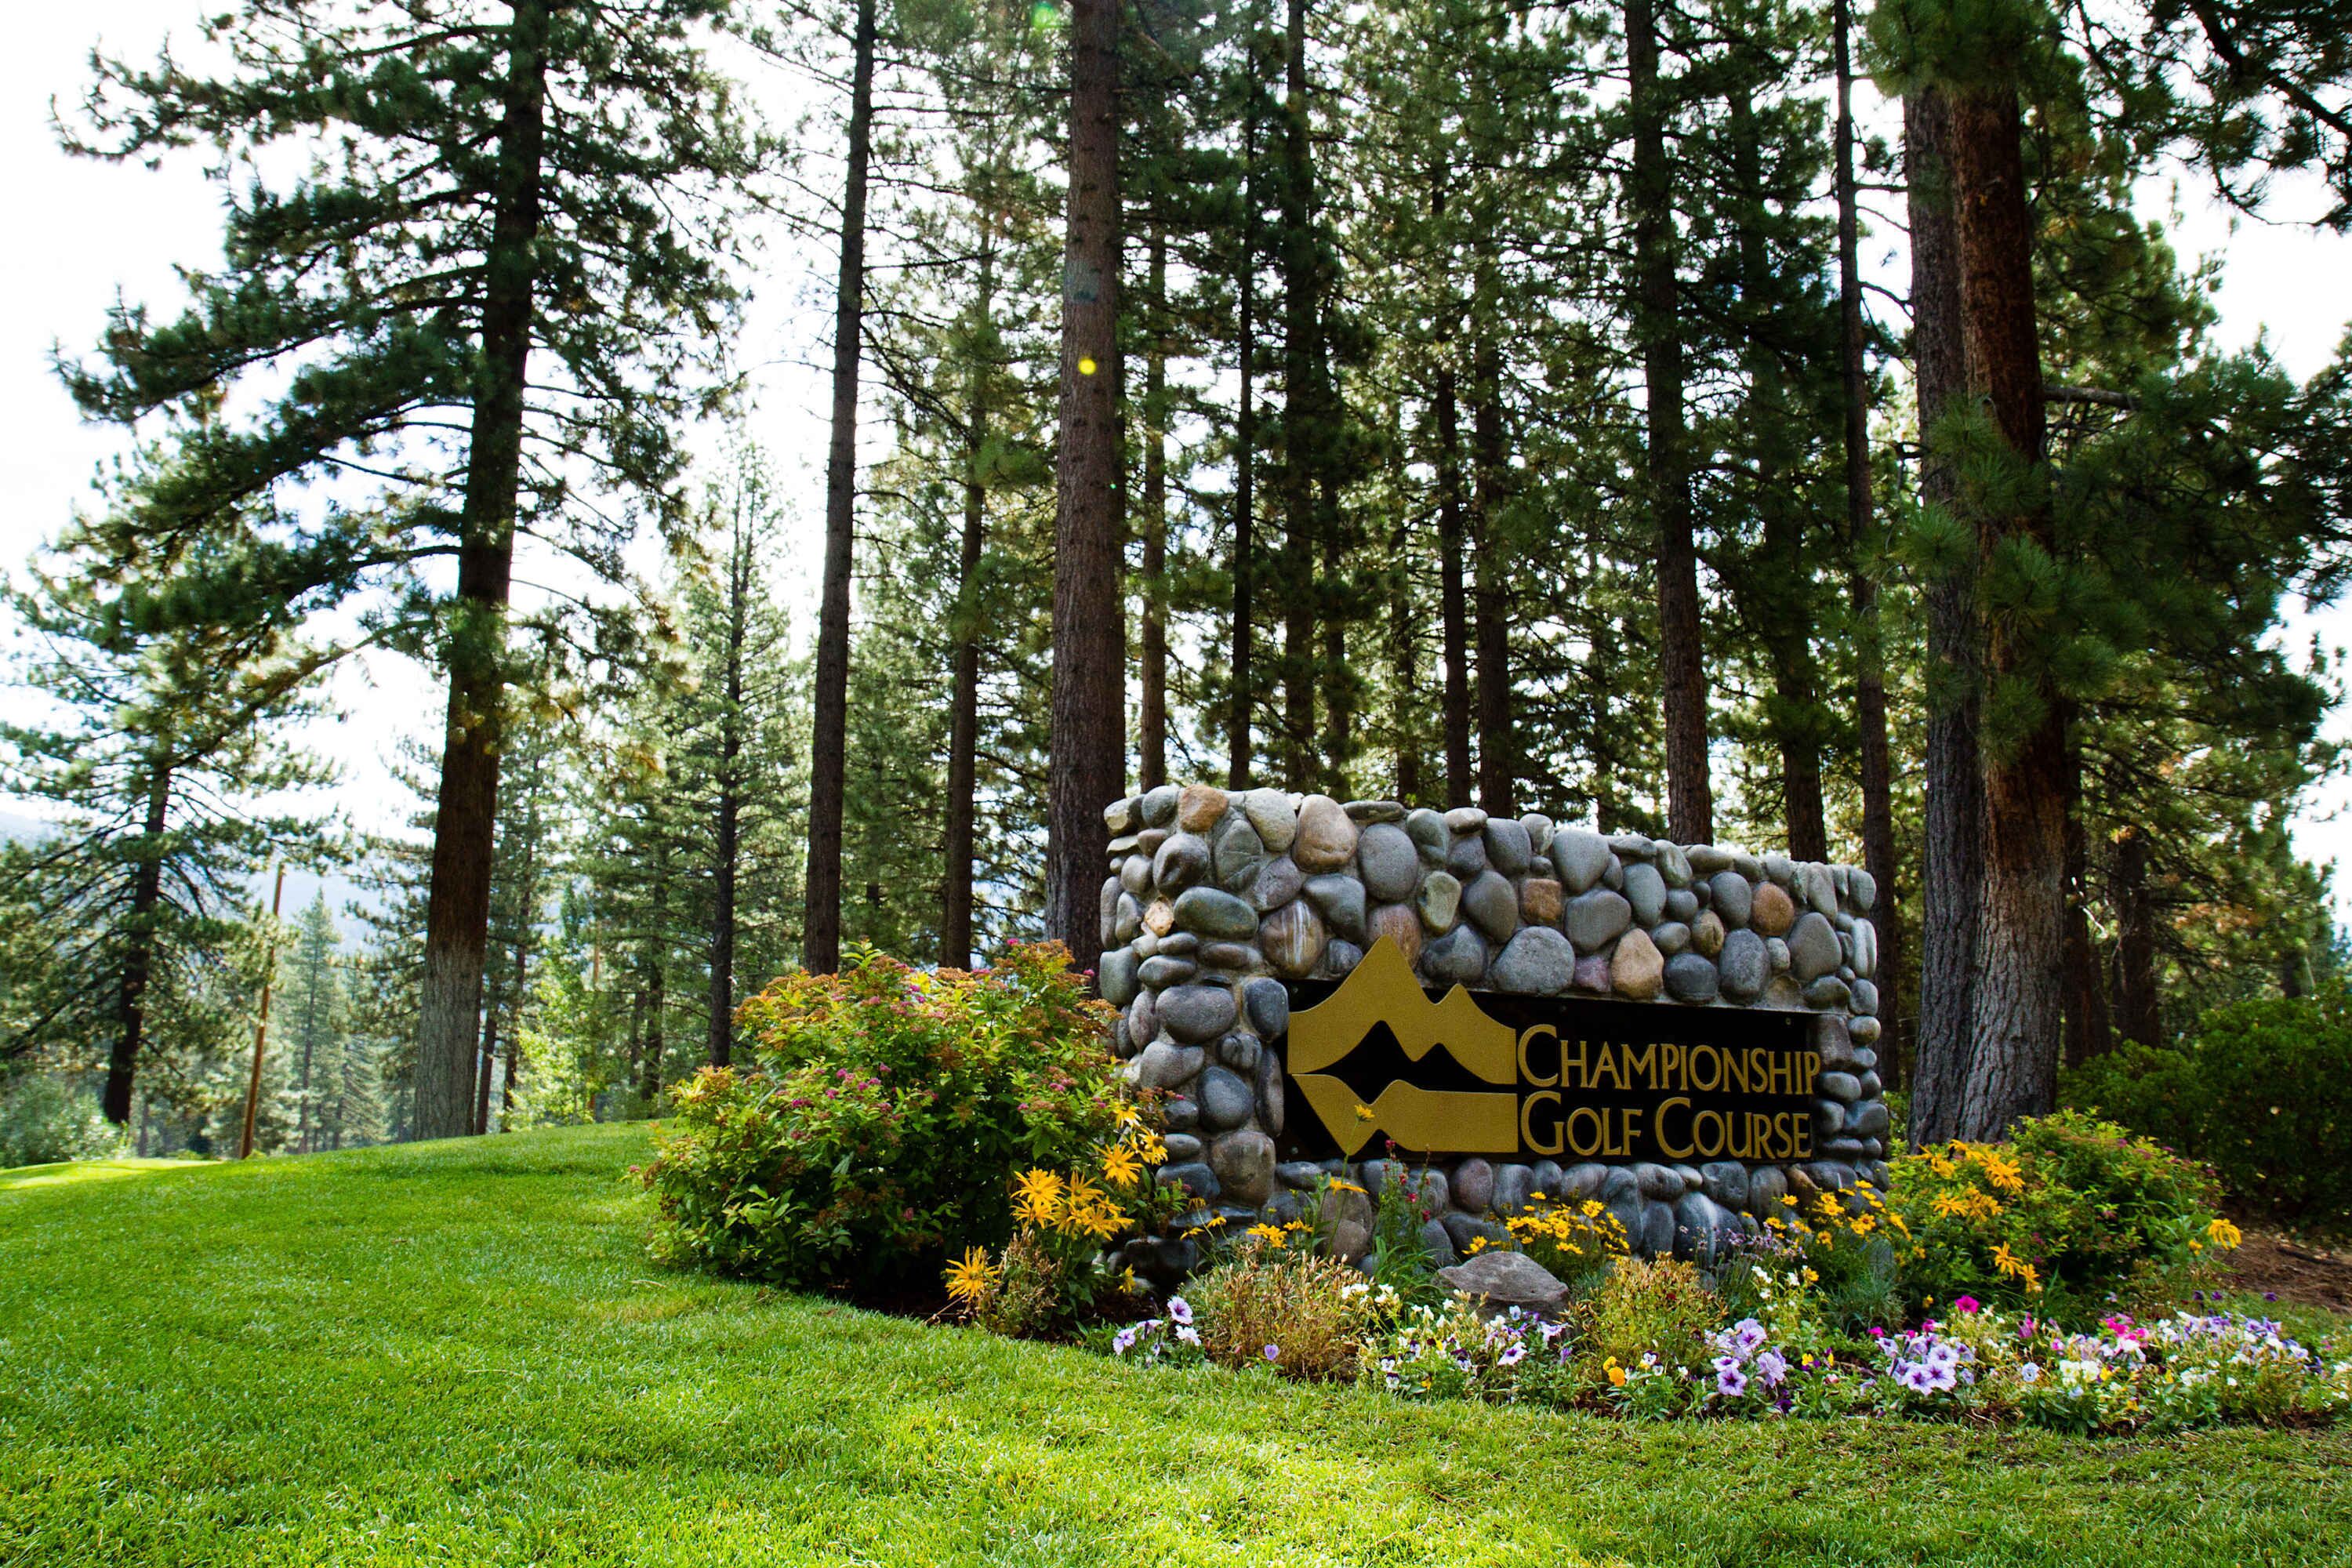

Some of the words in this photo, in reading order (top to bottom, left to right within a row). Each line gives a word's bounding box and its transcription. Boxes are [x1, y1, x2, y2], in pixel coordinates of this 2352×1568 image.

[1517, 1023, 1822, 1095] CHAMPIONSHIP
[1520, 1091, 1643, 1156] GOLF
[1654, 1097, 1813, 1160] COURSE
